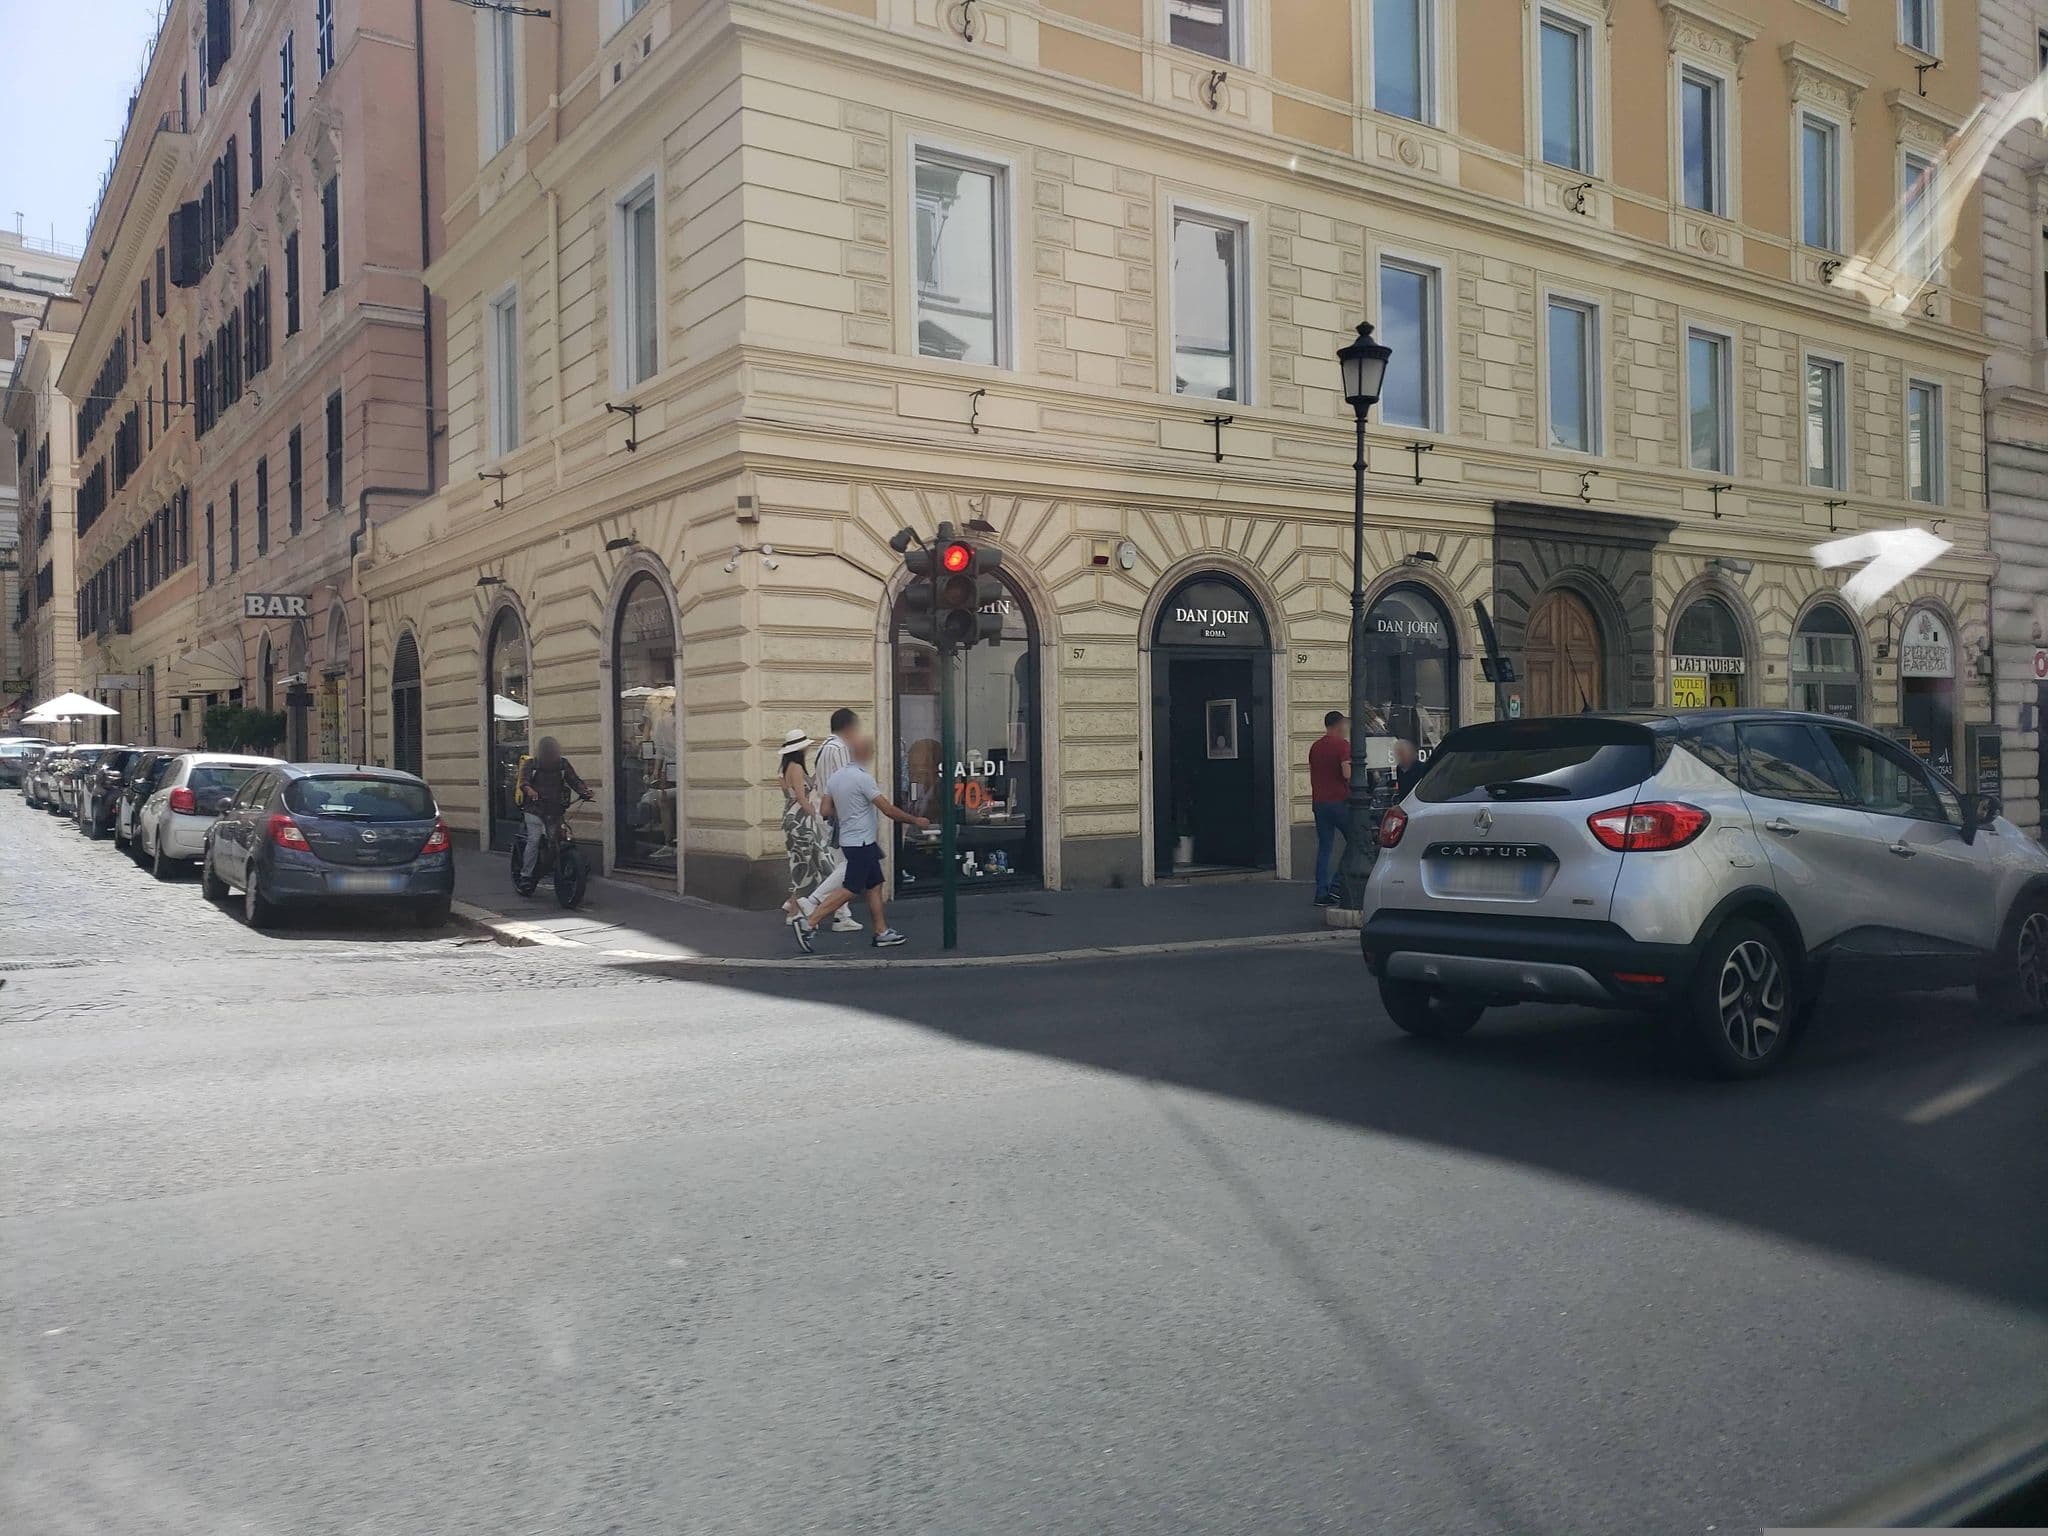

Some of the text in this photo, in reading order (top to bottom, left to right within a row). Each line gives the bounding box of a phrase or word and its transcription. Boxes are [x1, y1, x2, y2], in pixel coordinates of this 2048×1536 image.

[246, 595, 307, 616] BAR
[1176, 608, 1250, 627] DAN JOHN
[1205, 629, 1226, 637] ROMA
[1377, 620, 1439, 636] DAN JOHN
[1073, 648, 1085, 659] 57
[1297, 654, 1308, 663] 59
[1705, 658, 1741, 673] RUBEN
[1440, 846, 1528, 858] CAPTUR
